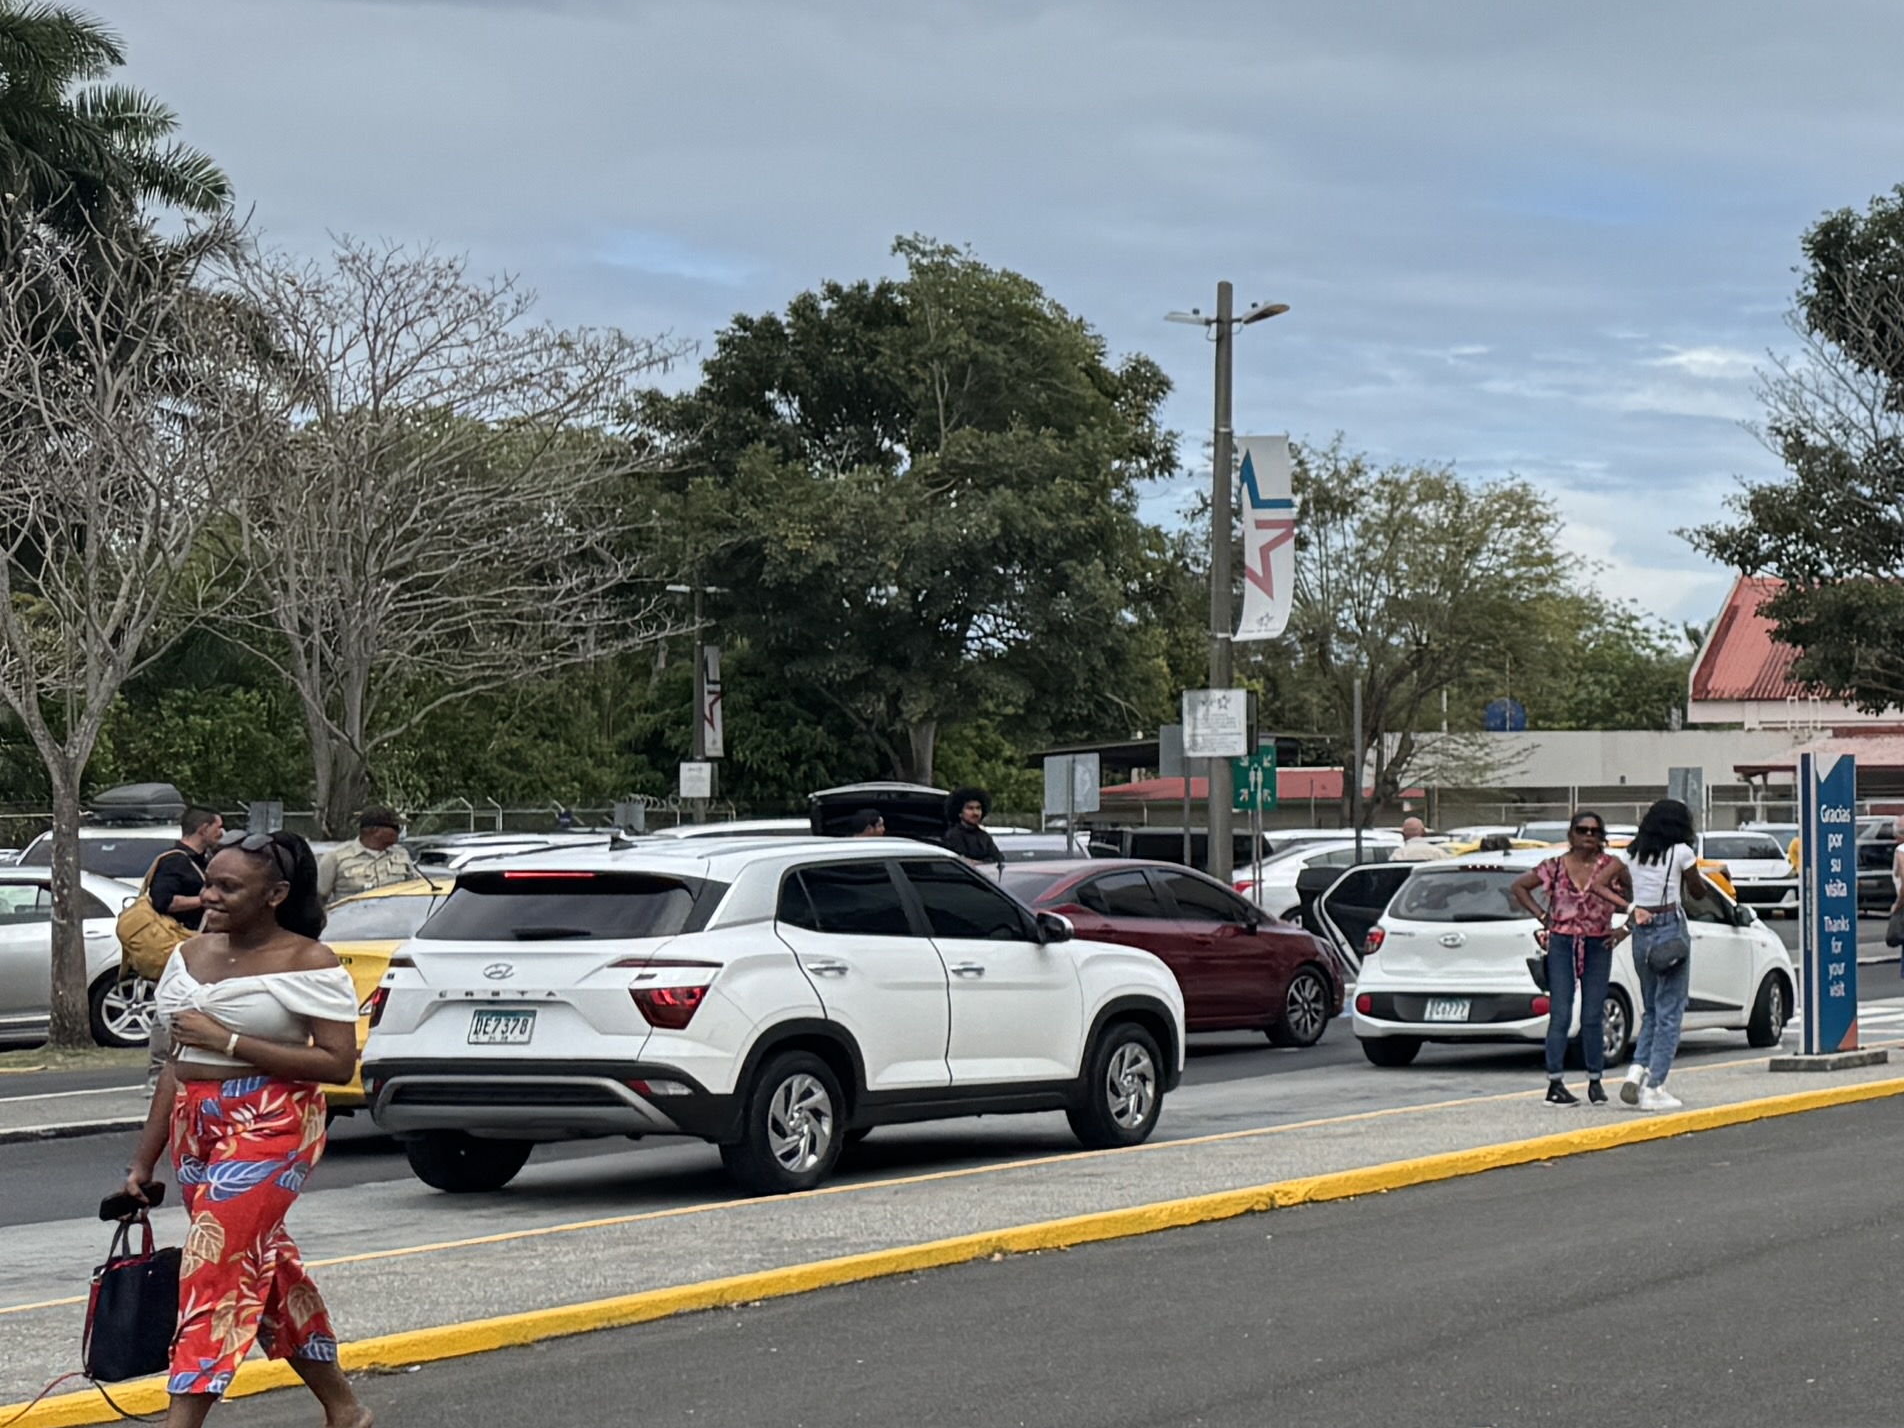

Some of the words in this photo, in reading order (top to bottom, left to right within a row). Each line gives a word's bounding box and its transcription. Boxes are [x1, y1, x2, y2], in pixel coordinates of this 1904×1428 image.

[1820, 804, 1851, 823] Gracias
[1828, 834, 1843, 852] por
[1830, 858, 1841, 873] su
[1825, 879, 1847, 897] visita
[1824, 915, 1849, 932] Thanks
[1831, 936, 1842, 954] for
[1829, 962, 1845, 980] your
[1830, 981, 1845, 997] visit
